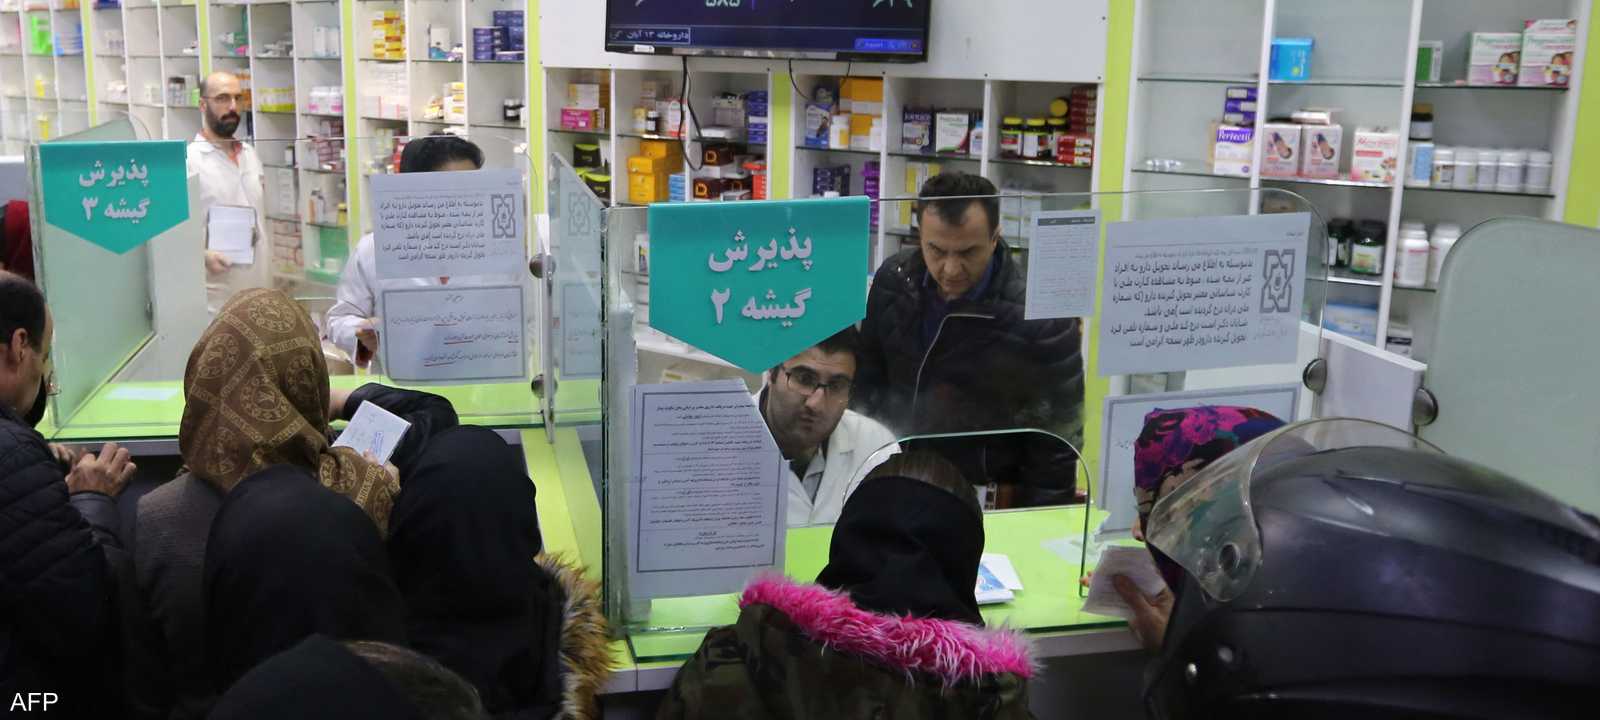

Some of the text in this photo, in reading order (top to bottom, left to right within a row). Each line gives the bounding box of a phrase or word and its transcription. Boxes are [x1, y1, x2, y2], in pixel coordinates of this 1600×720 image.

[79, 159, 149, 187] پذیرش
[82, 196, 150, 224] گیشه ۳
[708, 227, 813, 272] پذیرش
[710, 287, 812, 327] گیشه ۲
